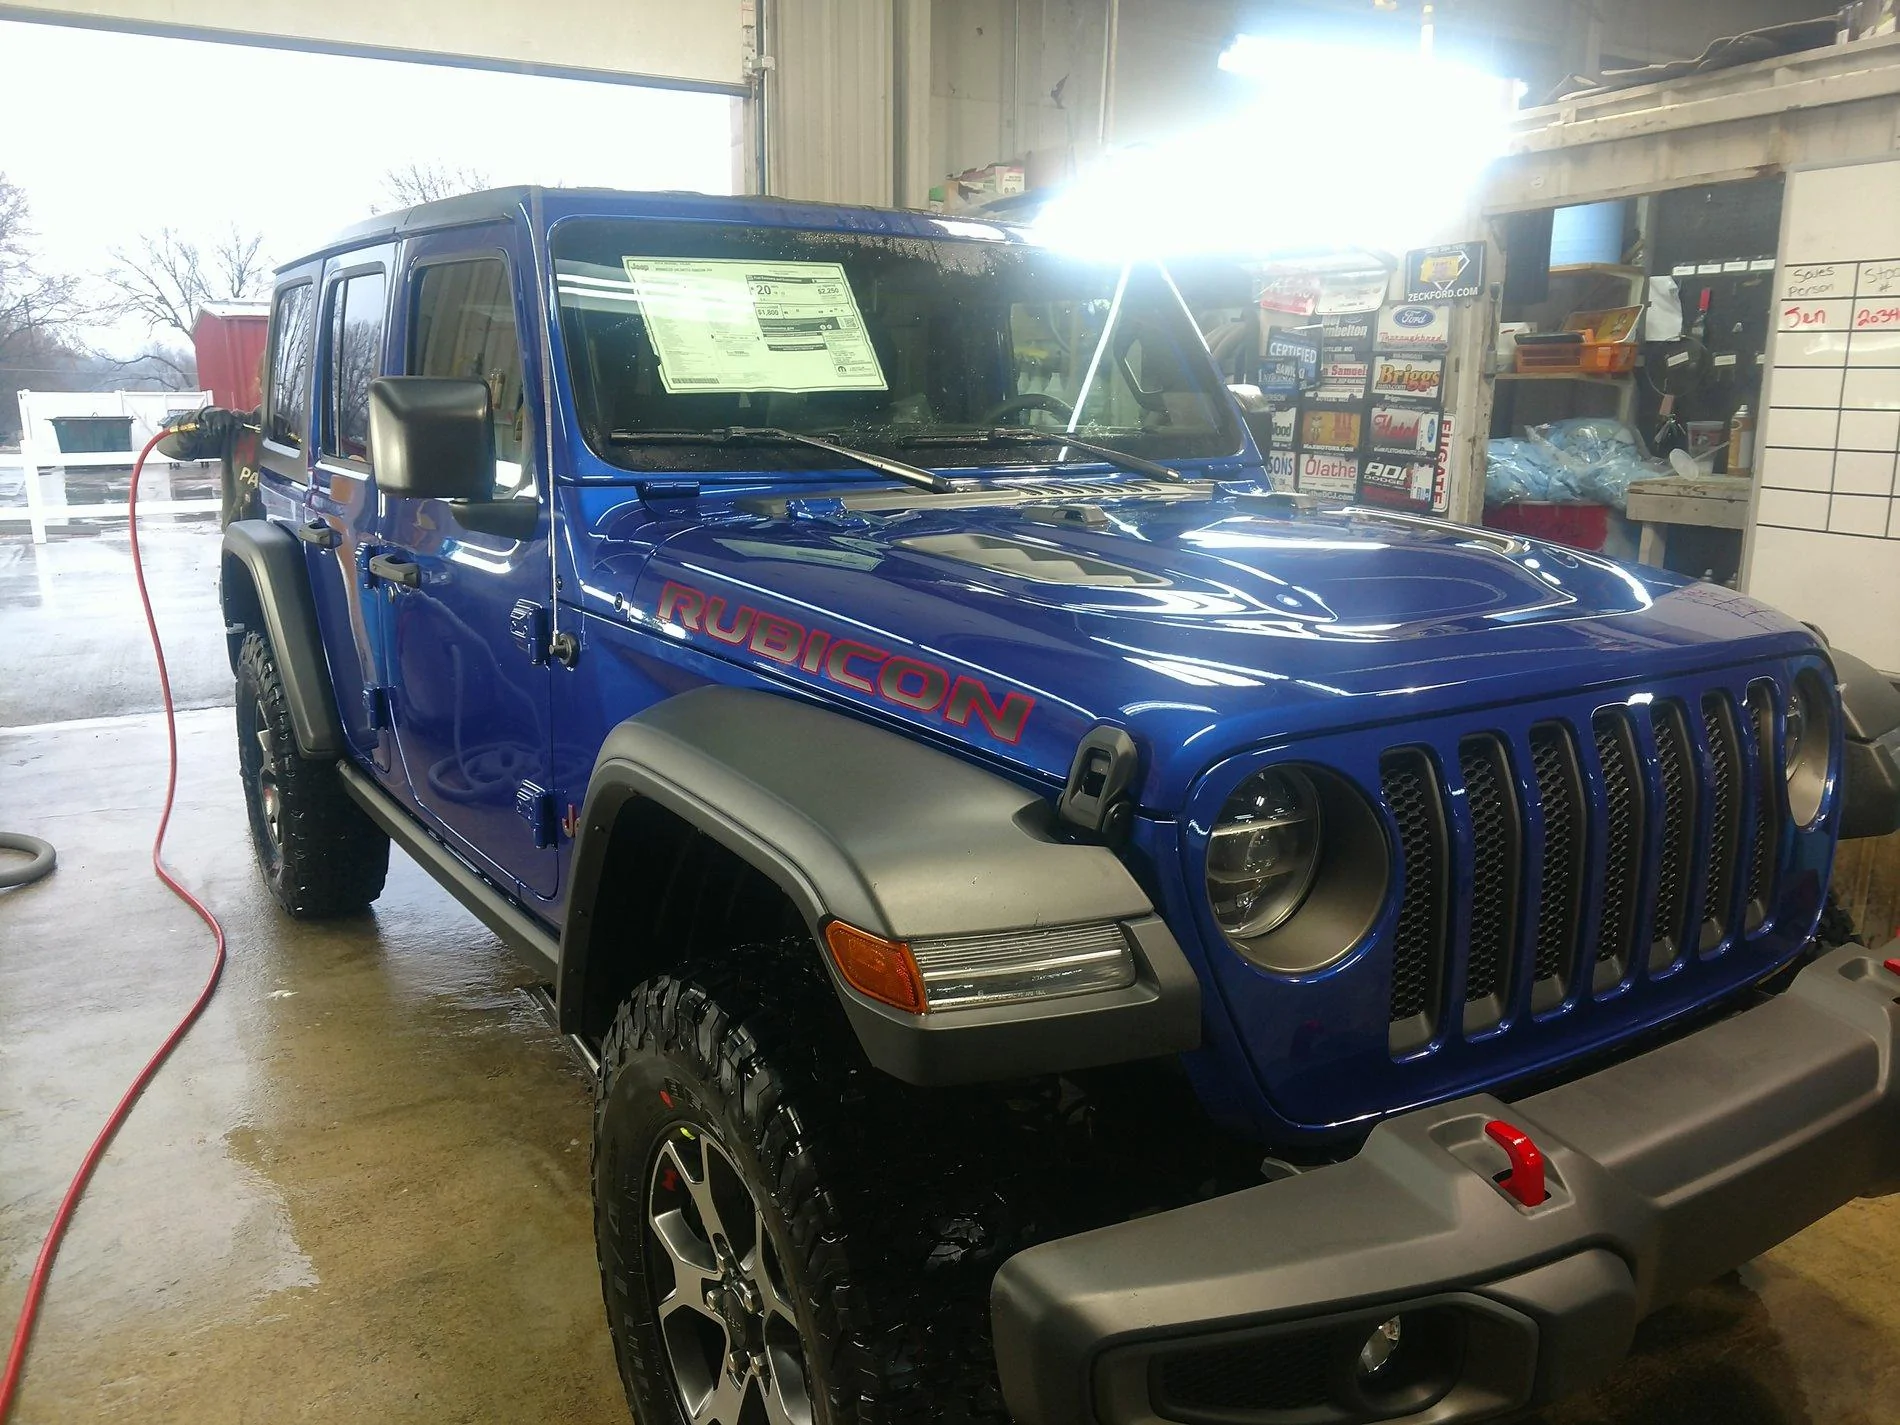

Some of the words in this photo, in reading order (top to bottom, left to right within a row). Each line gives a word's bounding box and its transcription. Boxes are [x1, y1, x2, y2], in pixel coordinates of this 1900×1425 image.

[756, 285, 771, 295] 20
[1408, 286, 1478, 303] ZECKFORD.COM
[1401, 309, 1428, 324] Ford
[1784, 306, 1826, 328] Jen
[1269, 342, 1317, 364] CERTIFIED
[1379, 363, 1440, 392] Briggs
[1305, 458, 1357, 478] Olathe
[1364, 474, 1404, 486] DODGE
[655, 580, 1036, 745] RUBICON
